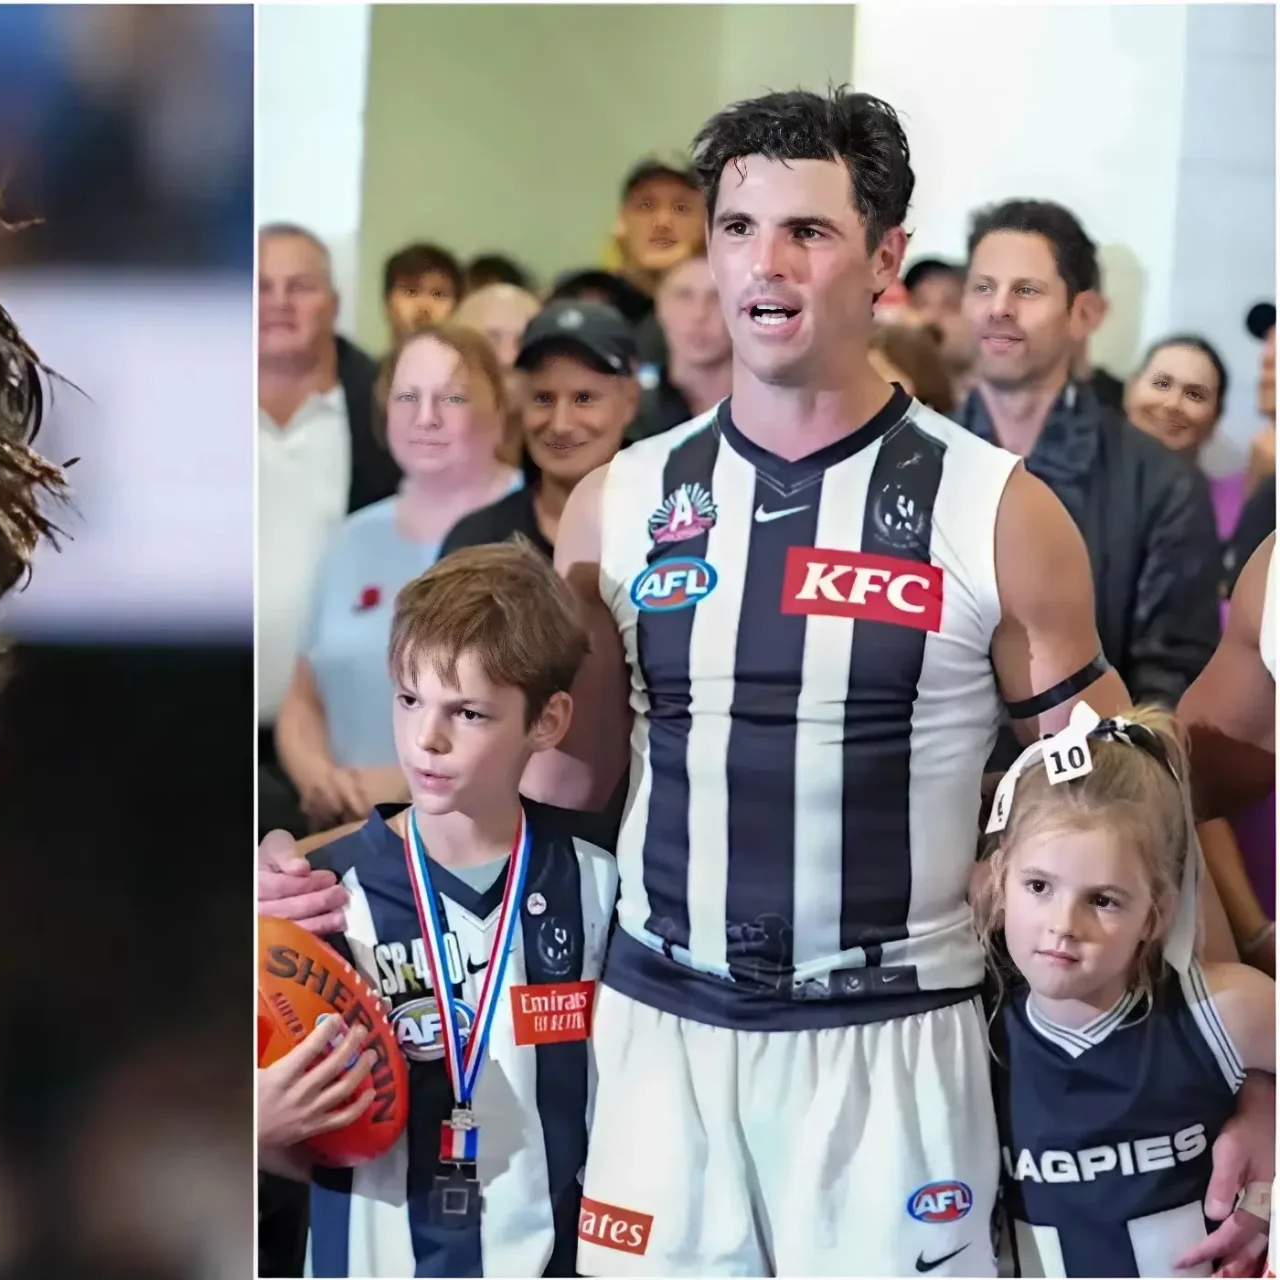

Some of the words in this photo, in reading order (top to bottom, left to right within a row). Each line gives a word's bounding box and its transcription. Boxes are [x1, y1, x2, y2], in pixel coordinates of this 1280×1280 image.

[636, 569, 709, 600] AFL
[795, 561, 931, 614] KFC
[1049, 746, 1086, 775] 10
[914, 1189, 970, 1217] AFL
